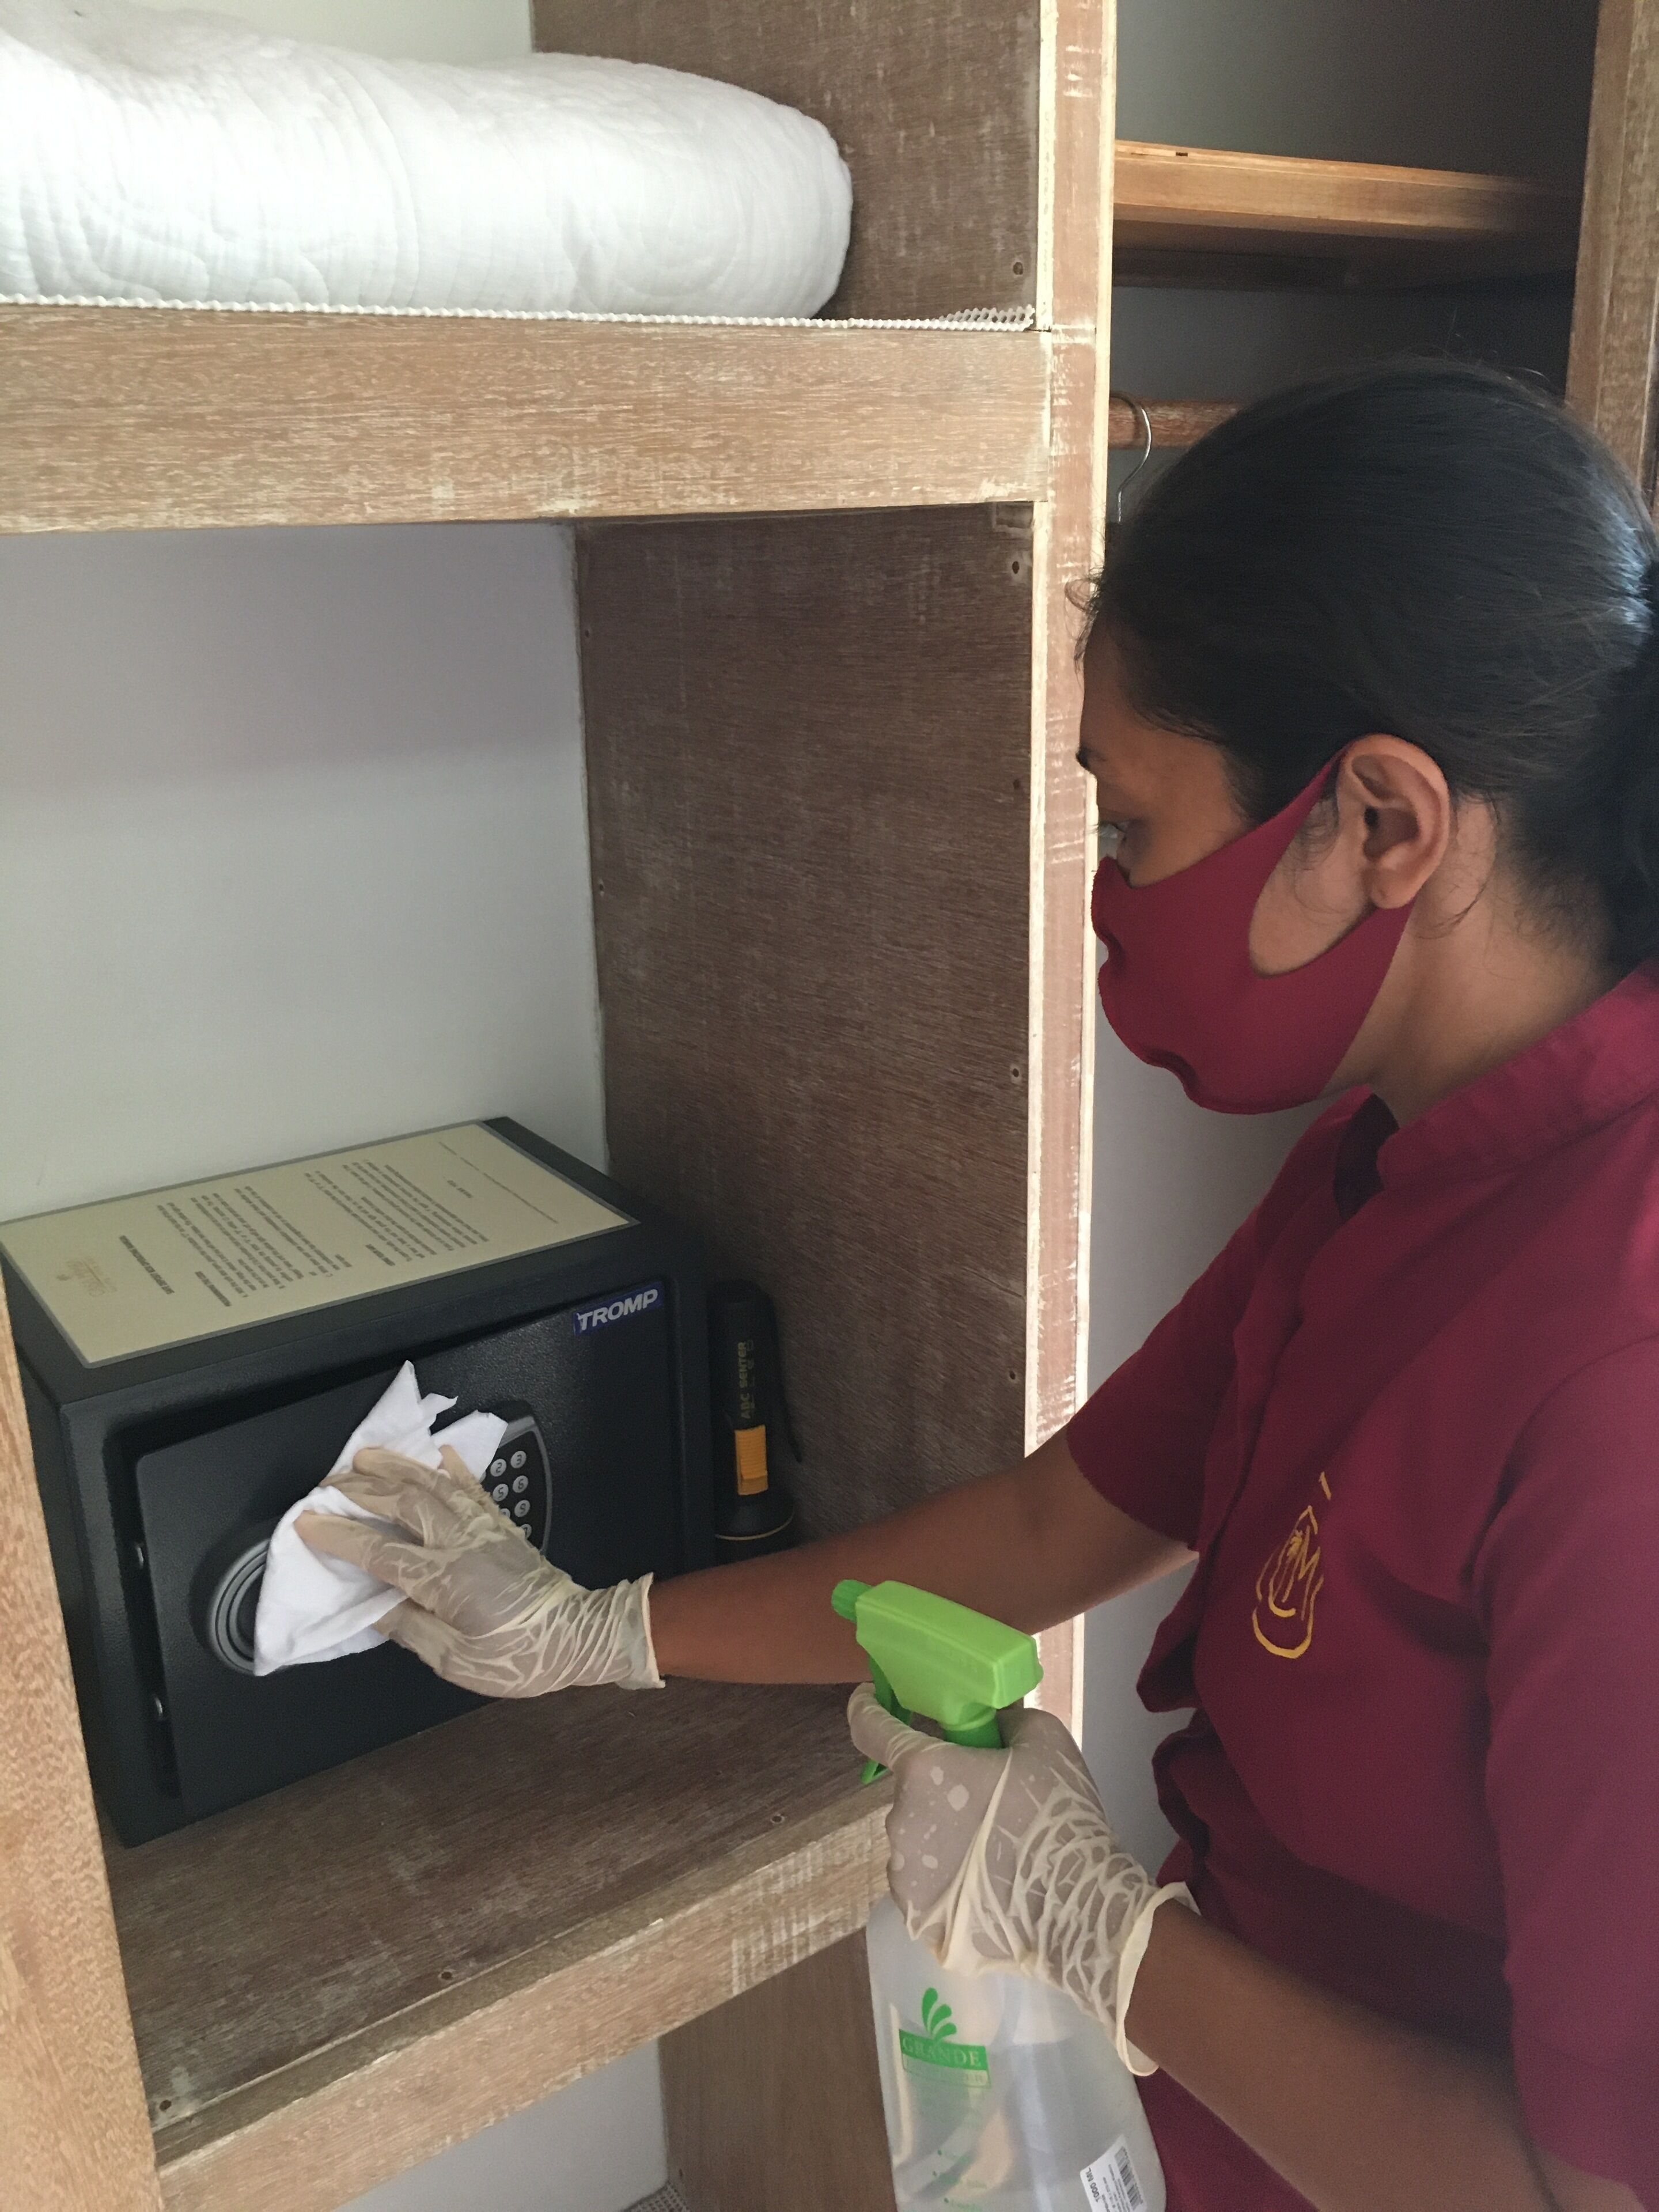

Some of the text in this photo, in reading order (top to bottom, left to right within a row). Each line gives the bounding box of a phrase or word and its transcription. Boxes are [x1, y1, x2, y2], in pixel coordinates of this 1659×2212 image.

[576, 1289, 658, 1334] TROMP
[496, 1455, 522, 1473] 2 3
[498, 1478, 524, 1499] 5 6
[520, 1503, 526, 1514] 9
[902, 2037, 982, 2067] GRANDE
[1086, 2168, 1101, 2202] 1000 ML
